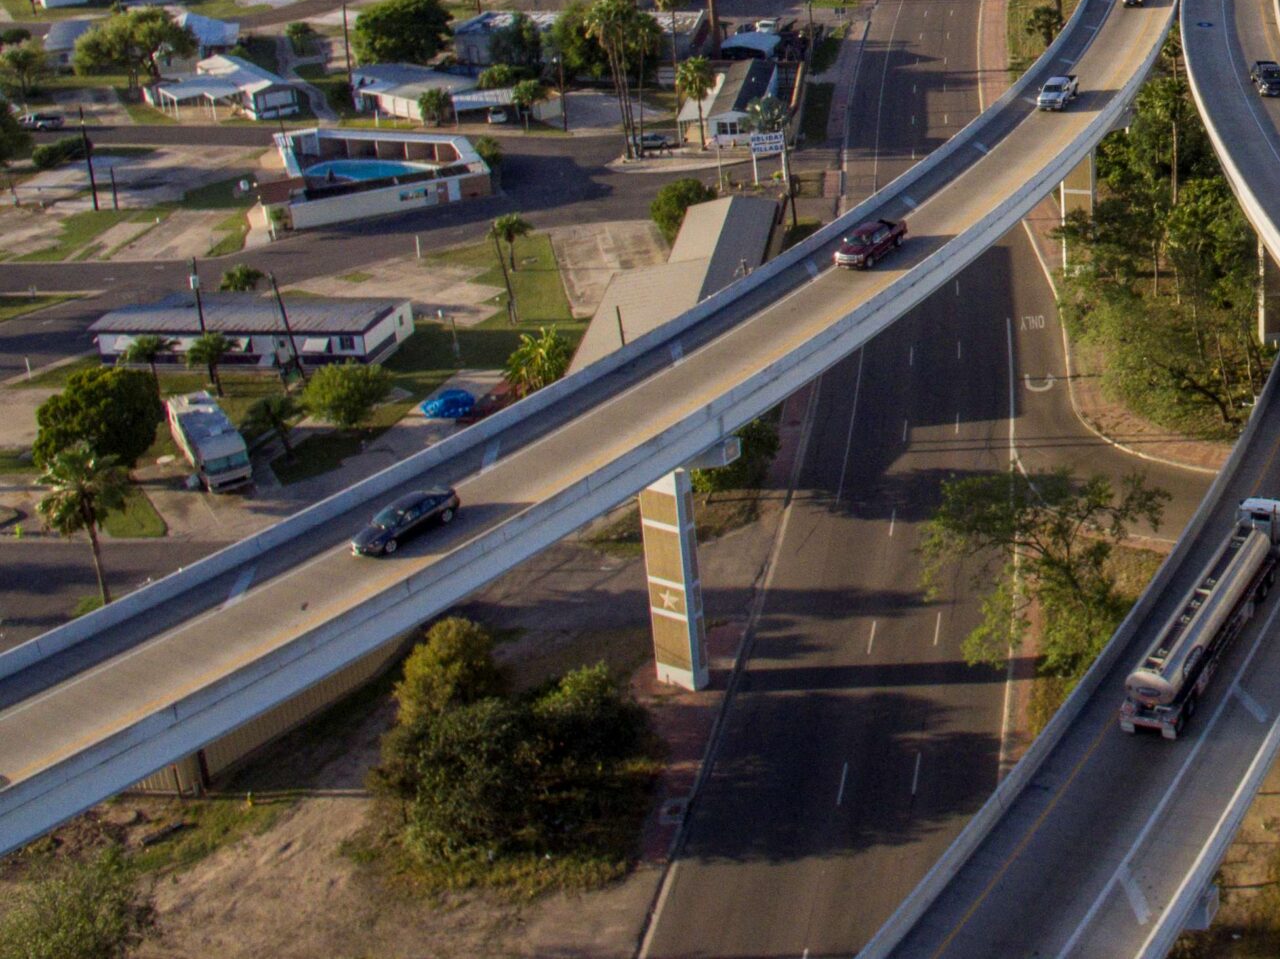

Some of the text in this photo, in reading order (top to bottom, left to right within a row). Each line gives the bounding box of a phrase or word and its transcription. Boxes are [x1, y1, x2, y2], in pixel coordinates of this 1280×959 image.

[751, 134, 783, 142] HOLIDAY
[752, 144, 783, 152] VILLAGE
[1020, 314, 1045, 331] ONLY
